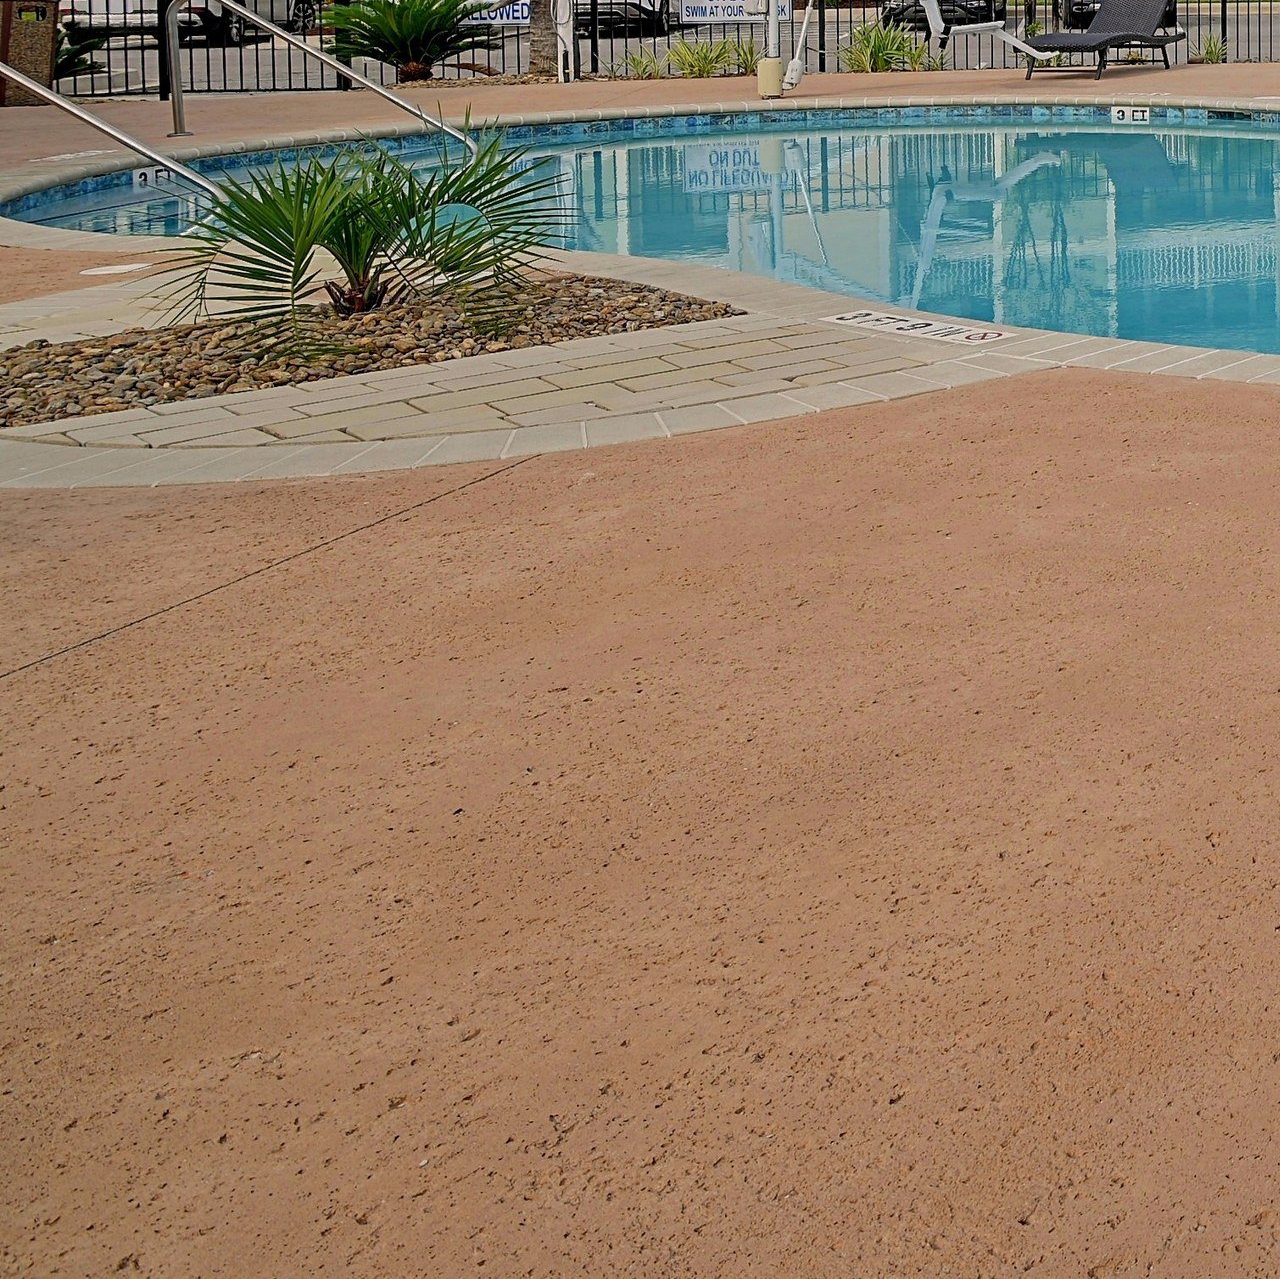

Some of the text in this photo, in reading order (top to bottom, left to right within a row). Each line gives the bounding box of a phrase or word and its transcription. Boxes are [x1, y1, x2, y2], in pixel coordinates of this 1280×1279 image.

[685, 5, 707, 17] SWIM
[709, 5, 719, 17] AT
[721, 5, 744, 17] YOUR
